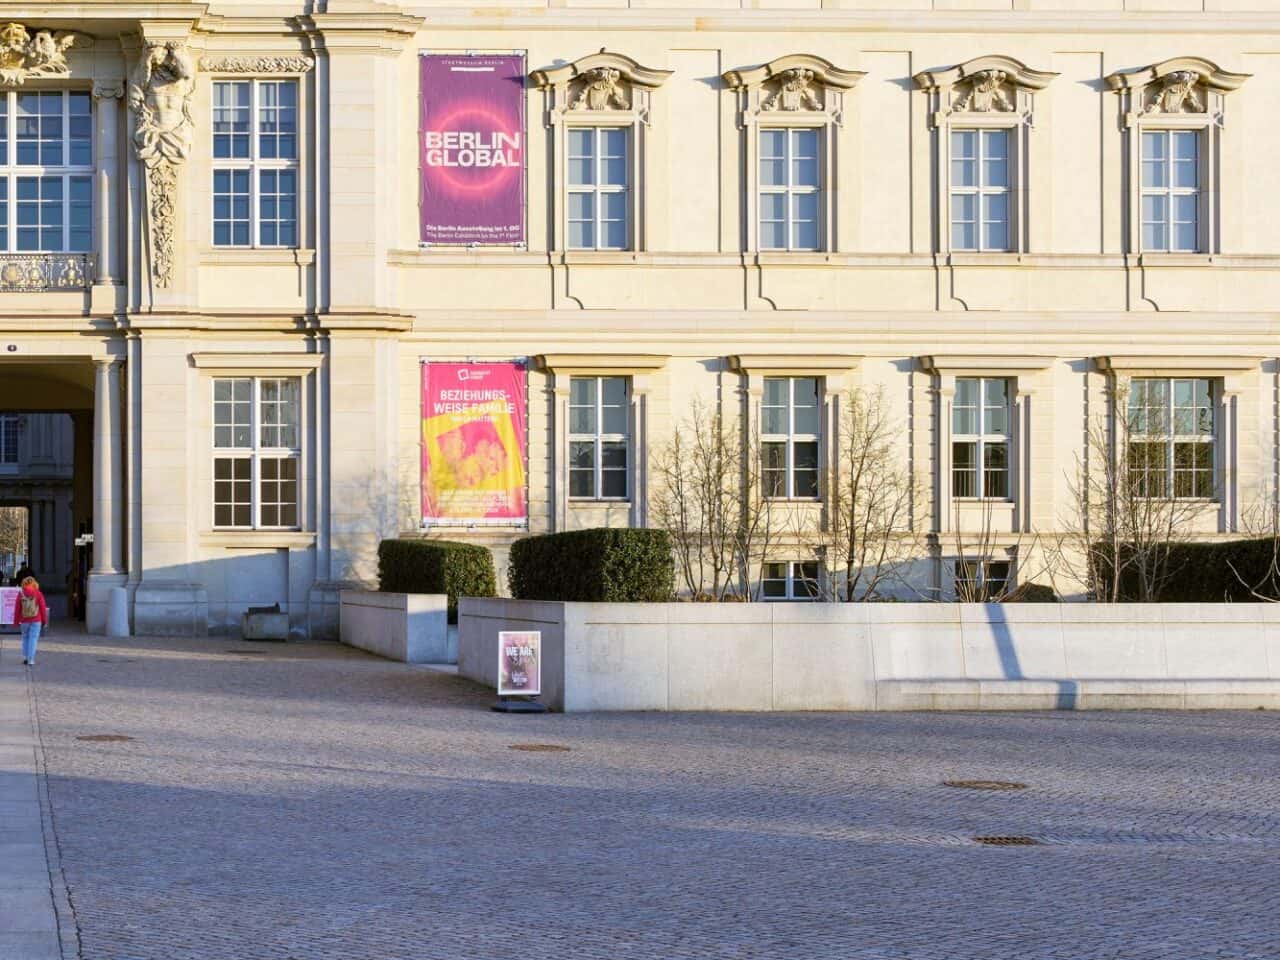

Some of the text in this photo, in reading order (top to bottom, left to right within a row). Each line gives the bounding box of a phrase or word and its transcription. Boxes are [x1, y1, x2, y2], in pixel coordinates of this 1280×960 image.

[425, 131, 520, 150] BERLIN
[426, 149, 520, 167] GLOBAL
[440, 390, 512, 401] BEZIEHUNGS-
[434, 403, 516, 414] WEISE FAMILIE
